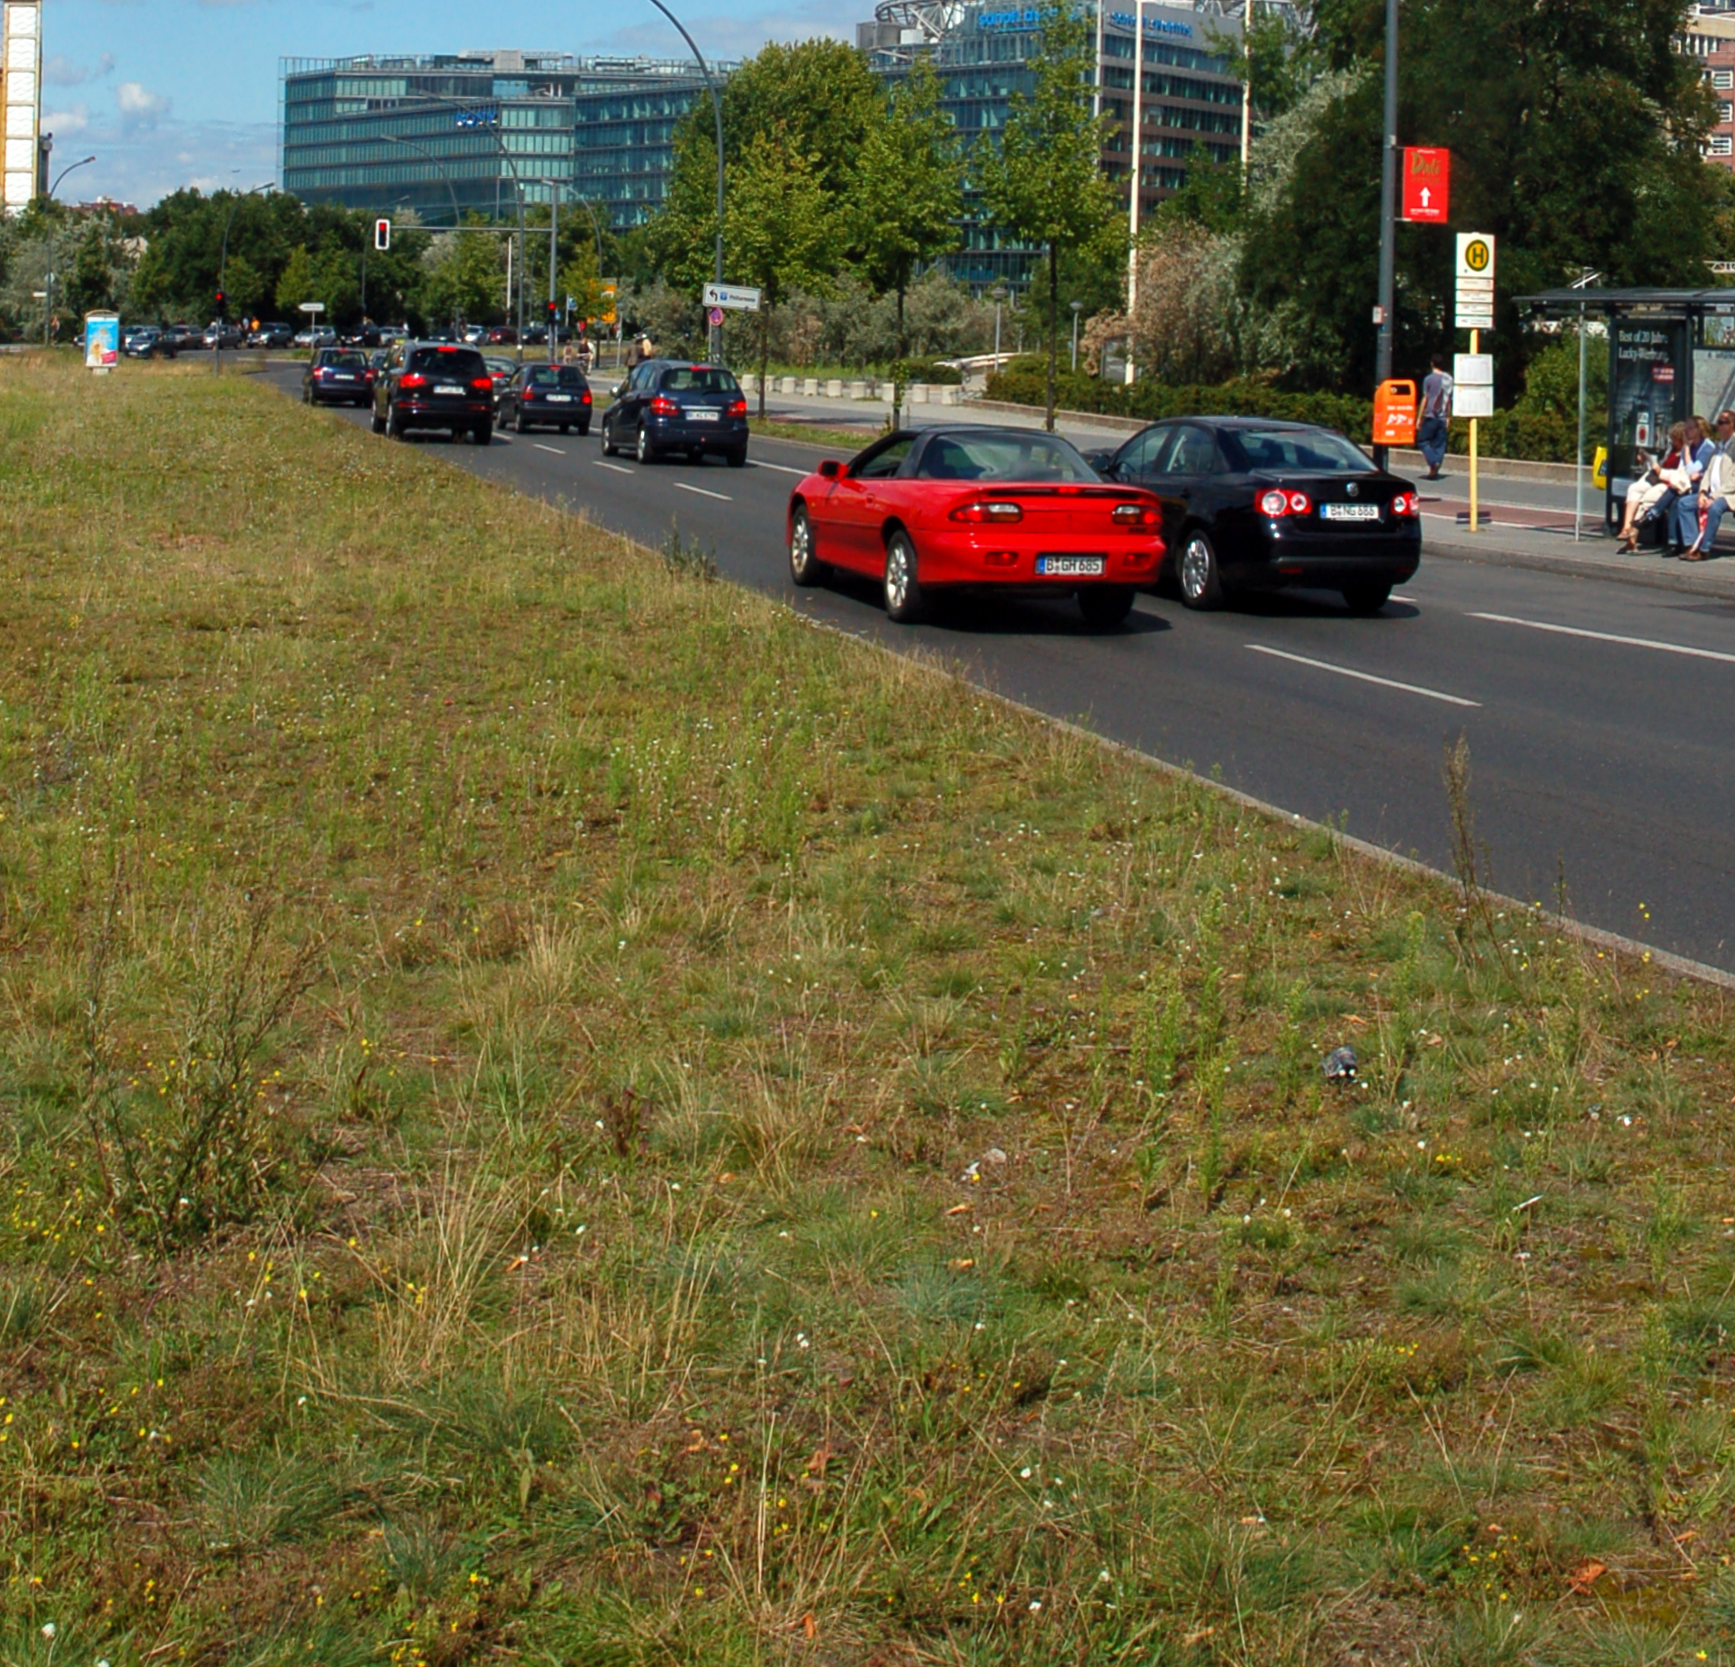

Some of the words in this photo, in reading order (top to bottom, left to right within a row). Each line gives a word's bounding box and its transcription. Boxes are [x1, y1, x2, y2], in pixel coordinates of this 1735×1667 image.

[1472, 247, 1484, 264] H
[1046, 558, 1054, 571] B
[1061, 558, 1076, 571] GH
